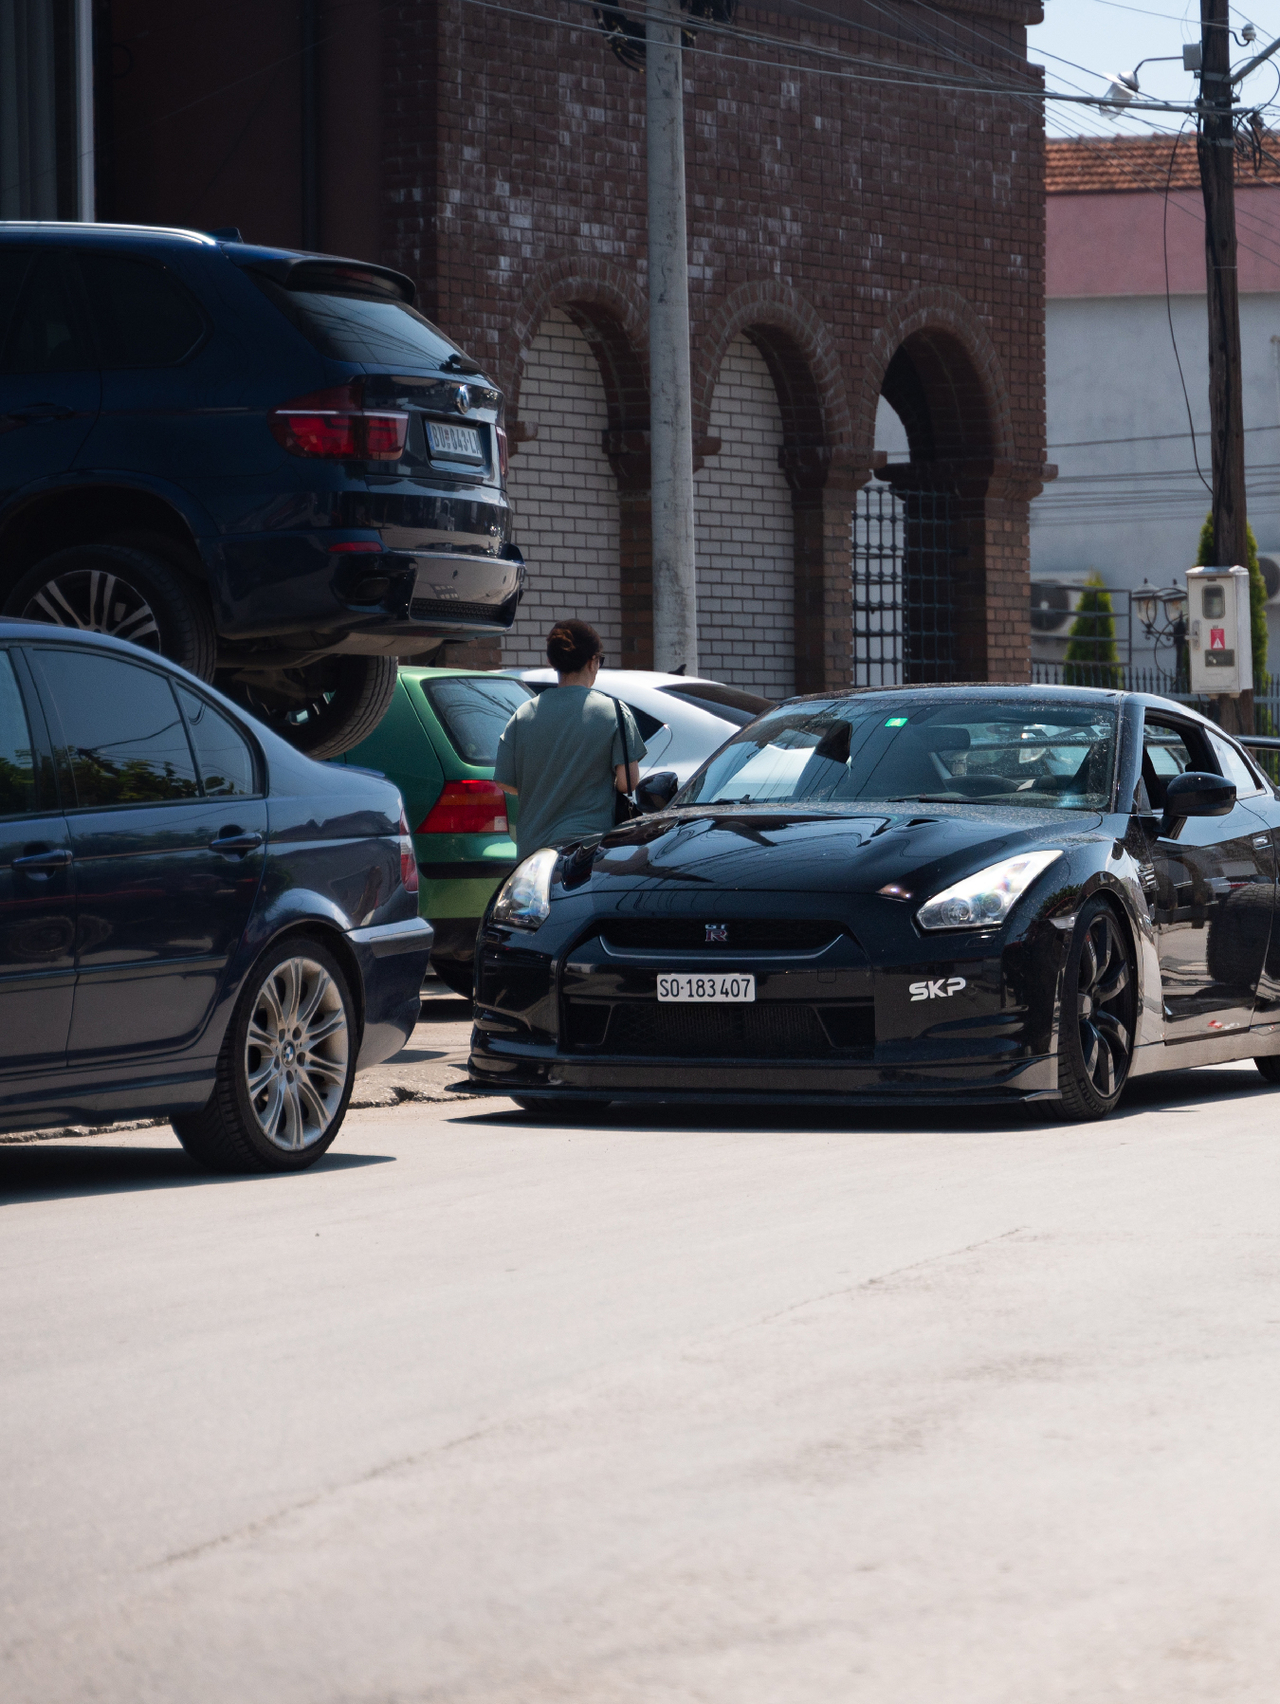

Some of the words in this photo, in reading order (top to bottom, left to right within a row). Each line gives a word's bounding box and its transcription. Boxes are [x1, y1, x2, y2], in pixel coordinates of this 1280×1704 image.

[431, 425, 446, 448] BU
[720, 978, 751, 998] 407
[908, 976, 967, 1002] SKP
